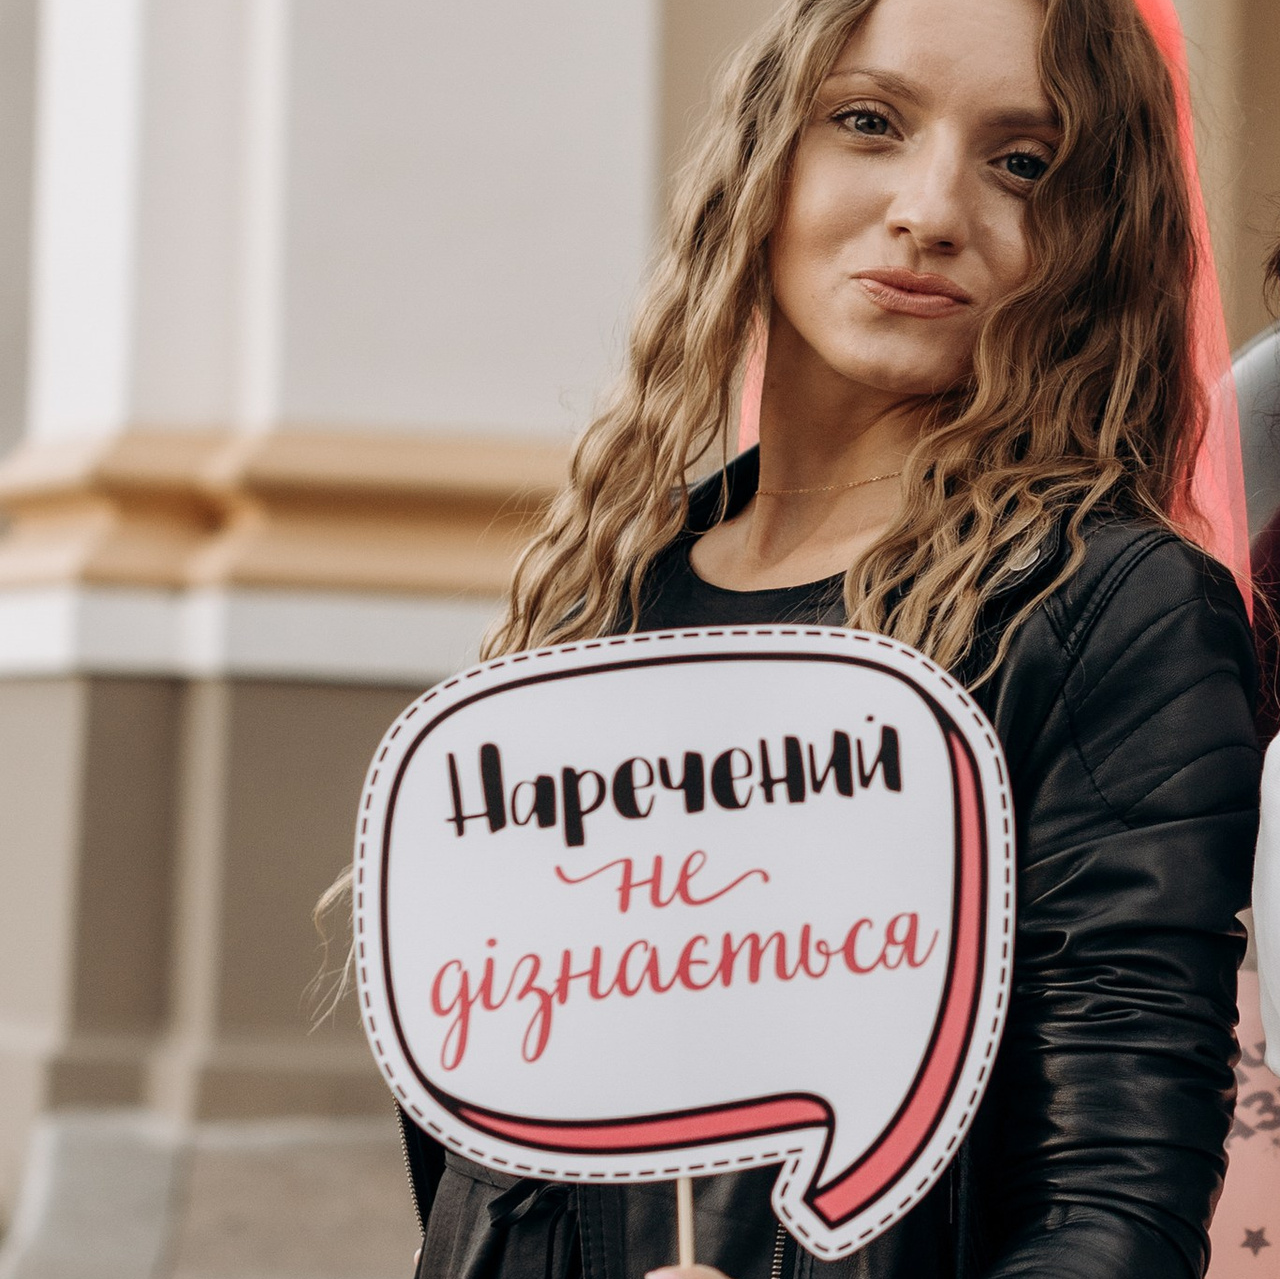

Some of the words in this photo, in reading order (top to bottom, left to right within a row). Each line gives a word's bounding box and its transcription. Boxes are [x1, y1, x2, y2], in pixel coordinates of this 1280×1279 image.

[445, 714, 903, 848] Наречений
[555, 849, 770, 914] не
[430, 911, 940, 1070] дізнається
